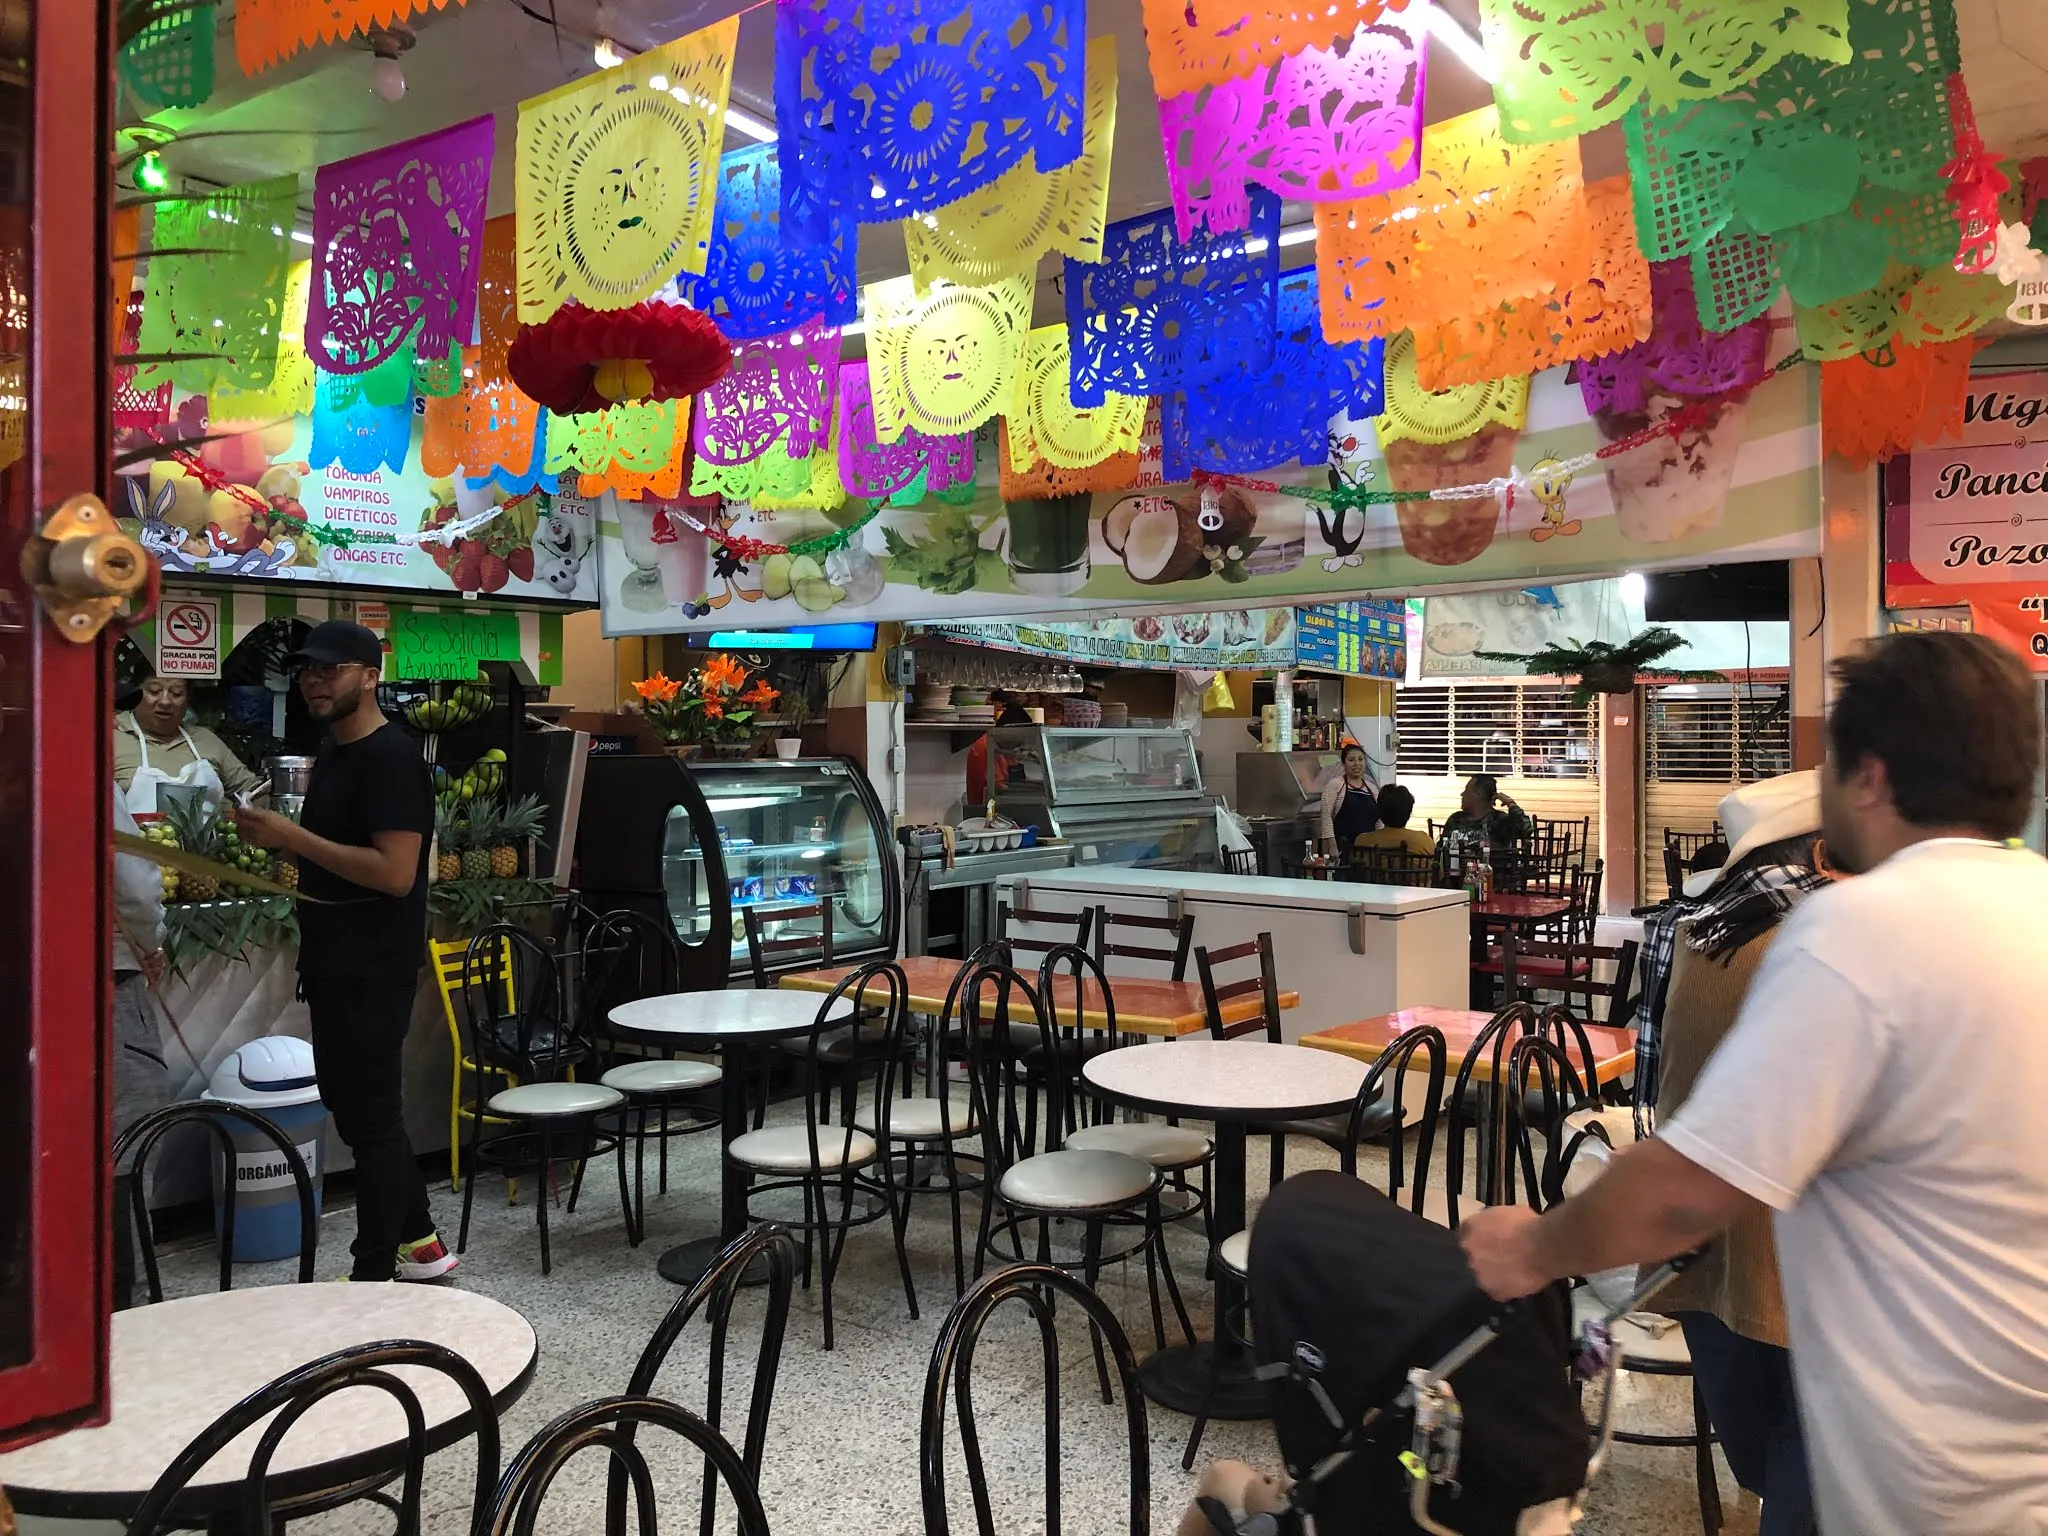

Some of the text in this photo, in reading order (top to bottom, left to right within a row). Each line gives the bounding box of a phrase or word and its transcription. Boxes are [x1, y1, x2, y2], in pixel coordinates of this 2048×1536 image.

[324, 485, 390, 504] VAMPIROS
[560, 503, 589, 516] ETC.
[1143, 496, 1173, 513] ETC.
[324, 505, 397, 525] DIETÉTICOS
[757, 510, 777, 522] ETC.
[333, 548, 407, 566] ONGAS ETC.
[404, 617, 499, 658] Se Solicita
[163, 660, 214, 670] NO FUMAR
[599, 741, 621, 751] pepsi
[238, 1162, 296, 1180] ORGÁNI
